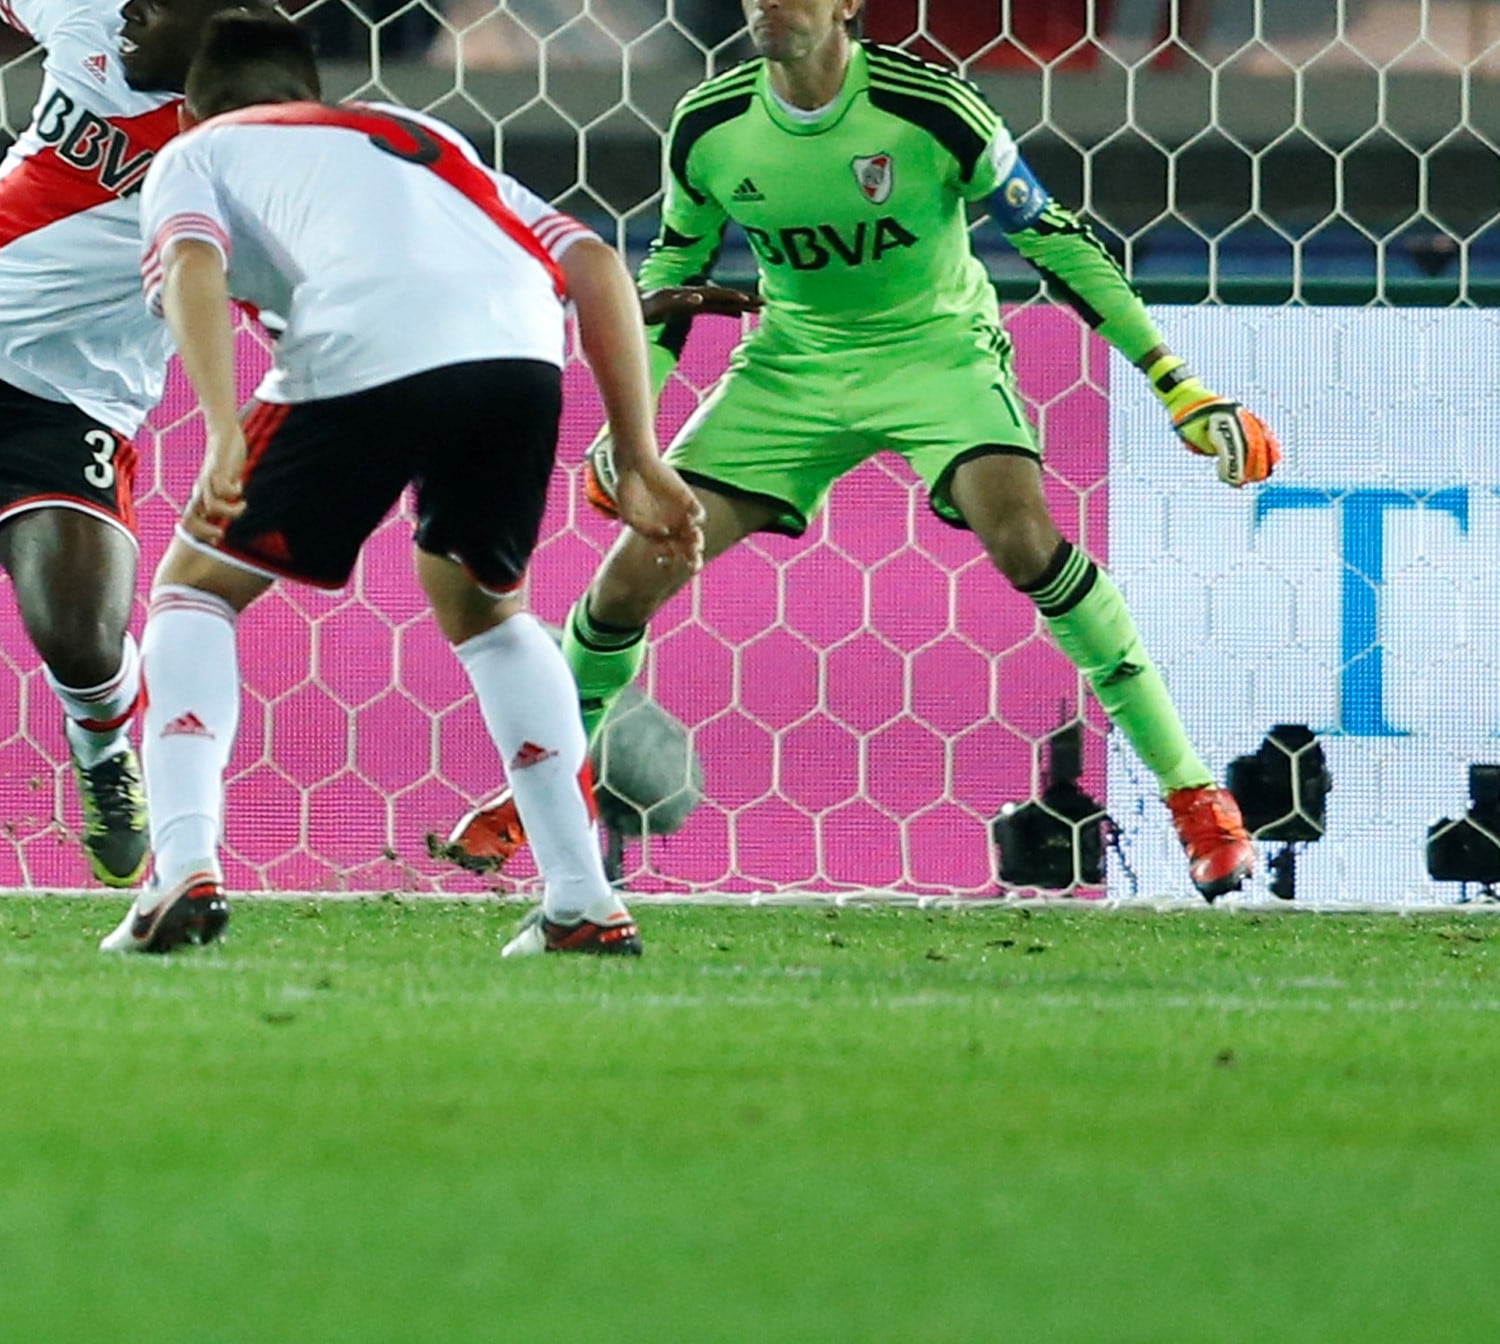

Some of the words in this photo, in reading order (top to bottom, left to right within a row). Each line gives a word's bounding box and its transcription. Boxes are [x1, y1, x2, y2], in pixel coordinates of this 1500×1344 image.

[743, 216, 919, 271] BBVA
[990, 383, 1022, 428] 1
[83, 429, 115, 490] 3
[1254, 485, 1500, 737] T
